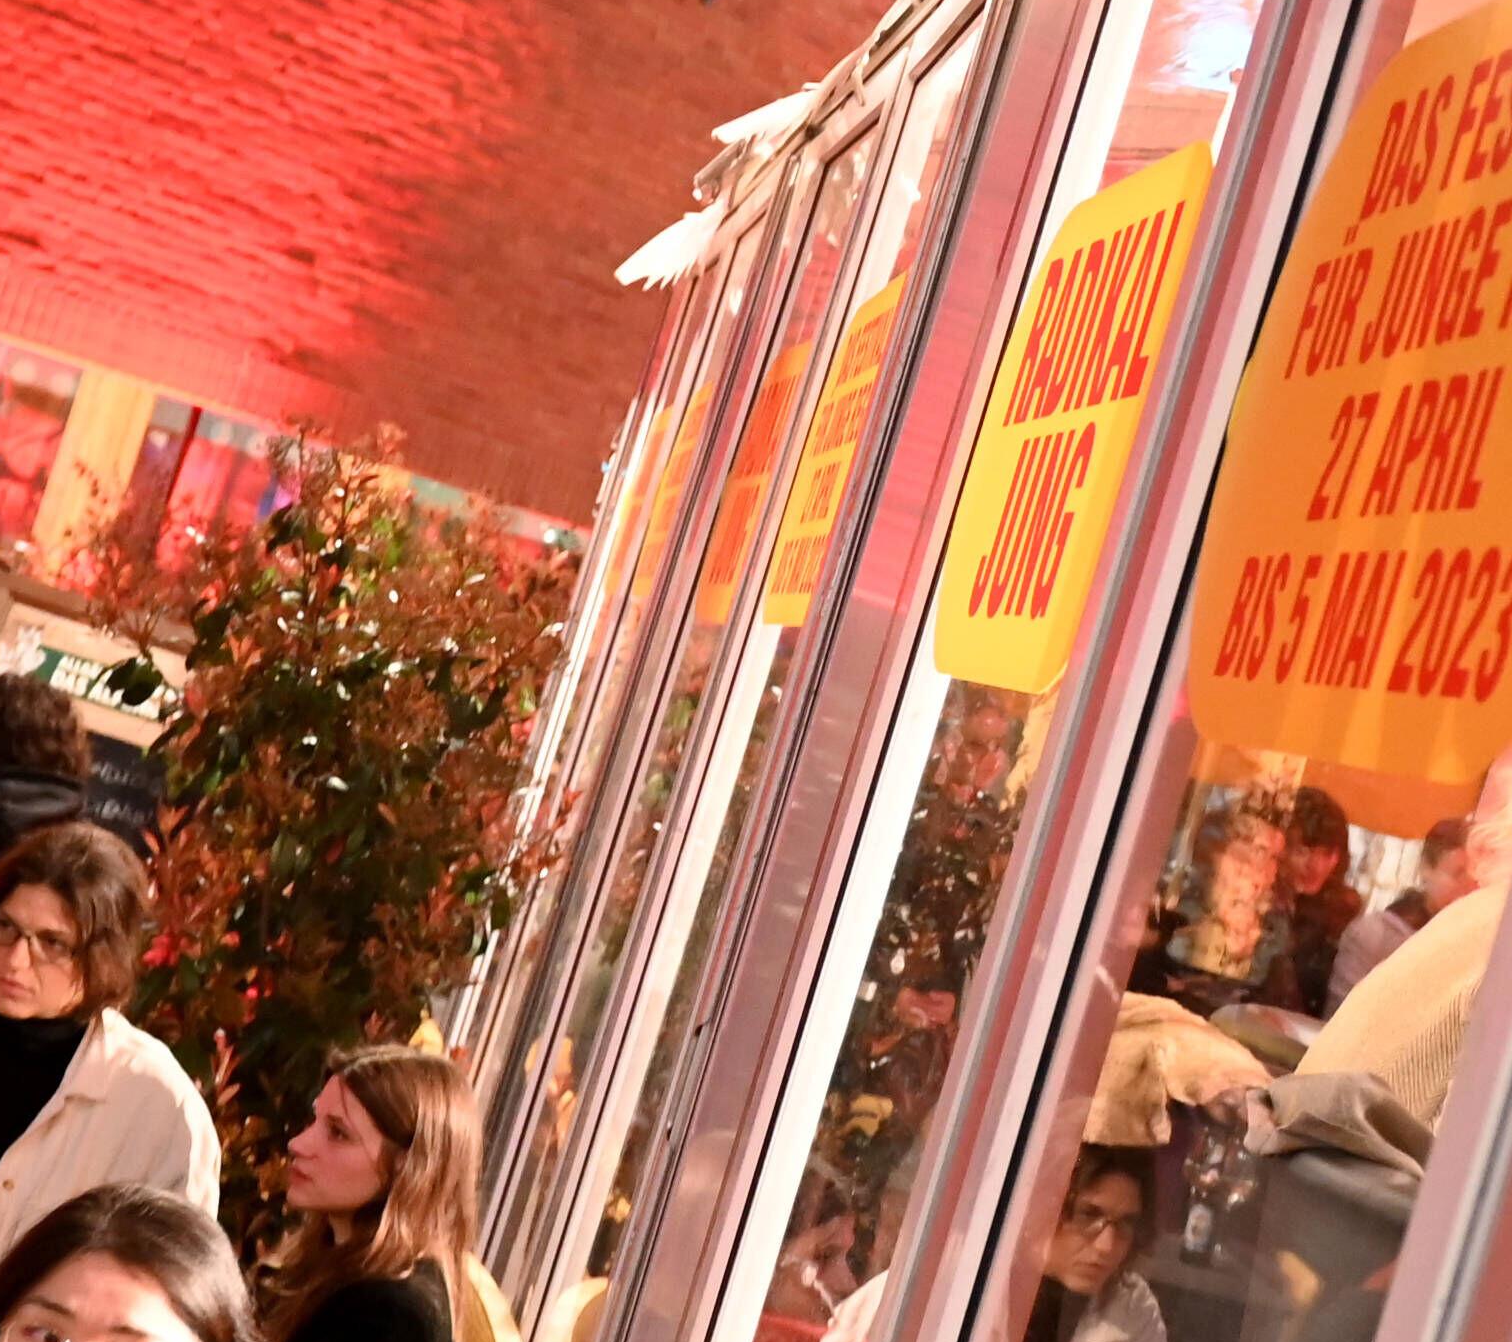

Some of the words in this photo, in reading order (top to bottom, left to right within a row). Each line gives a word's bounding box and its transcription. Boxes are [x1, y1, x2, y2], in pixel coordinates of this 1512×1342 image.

[1358, 75, 1455, 223] DAS
[1003, 200, 1187, 427] RADIKAL
[1284, 223, 1374, 380] FÜR
[968, 421, 1096, 619] JUNG
[1306, 392, 1381, 522] 27
[1359, 365, 1505, 518] APRIL
[1213, 552, 1292, 682] BIS
[1275, 555, 1324, 685] 5
[1303, 550, 1408, 690] MAI
